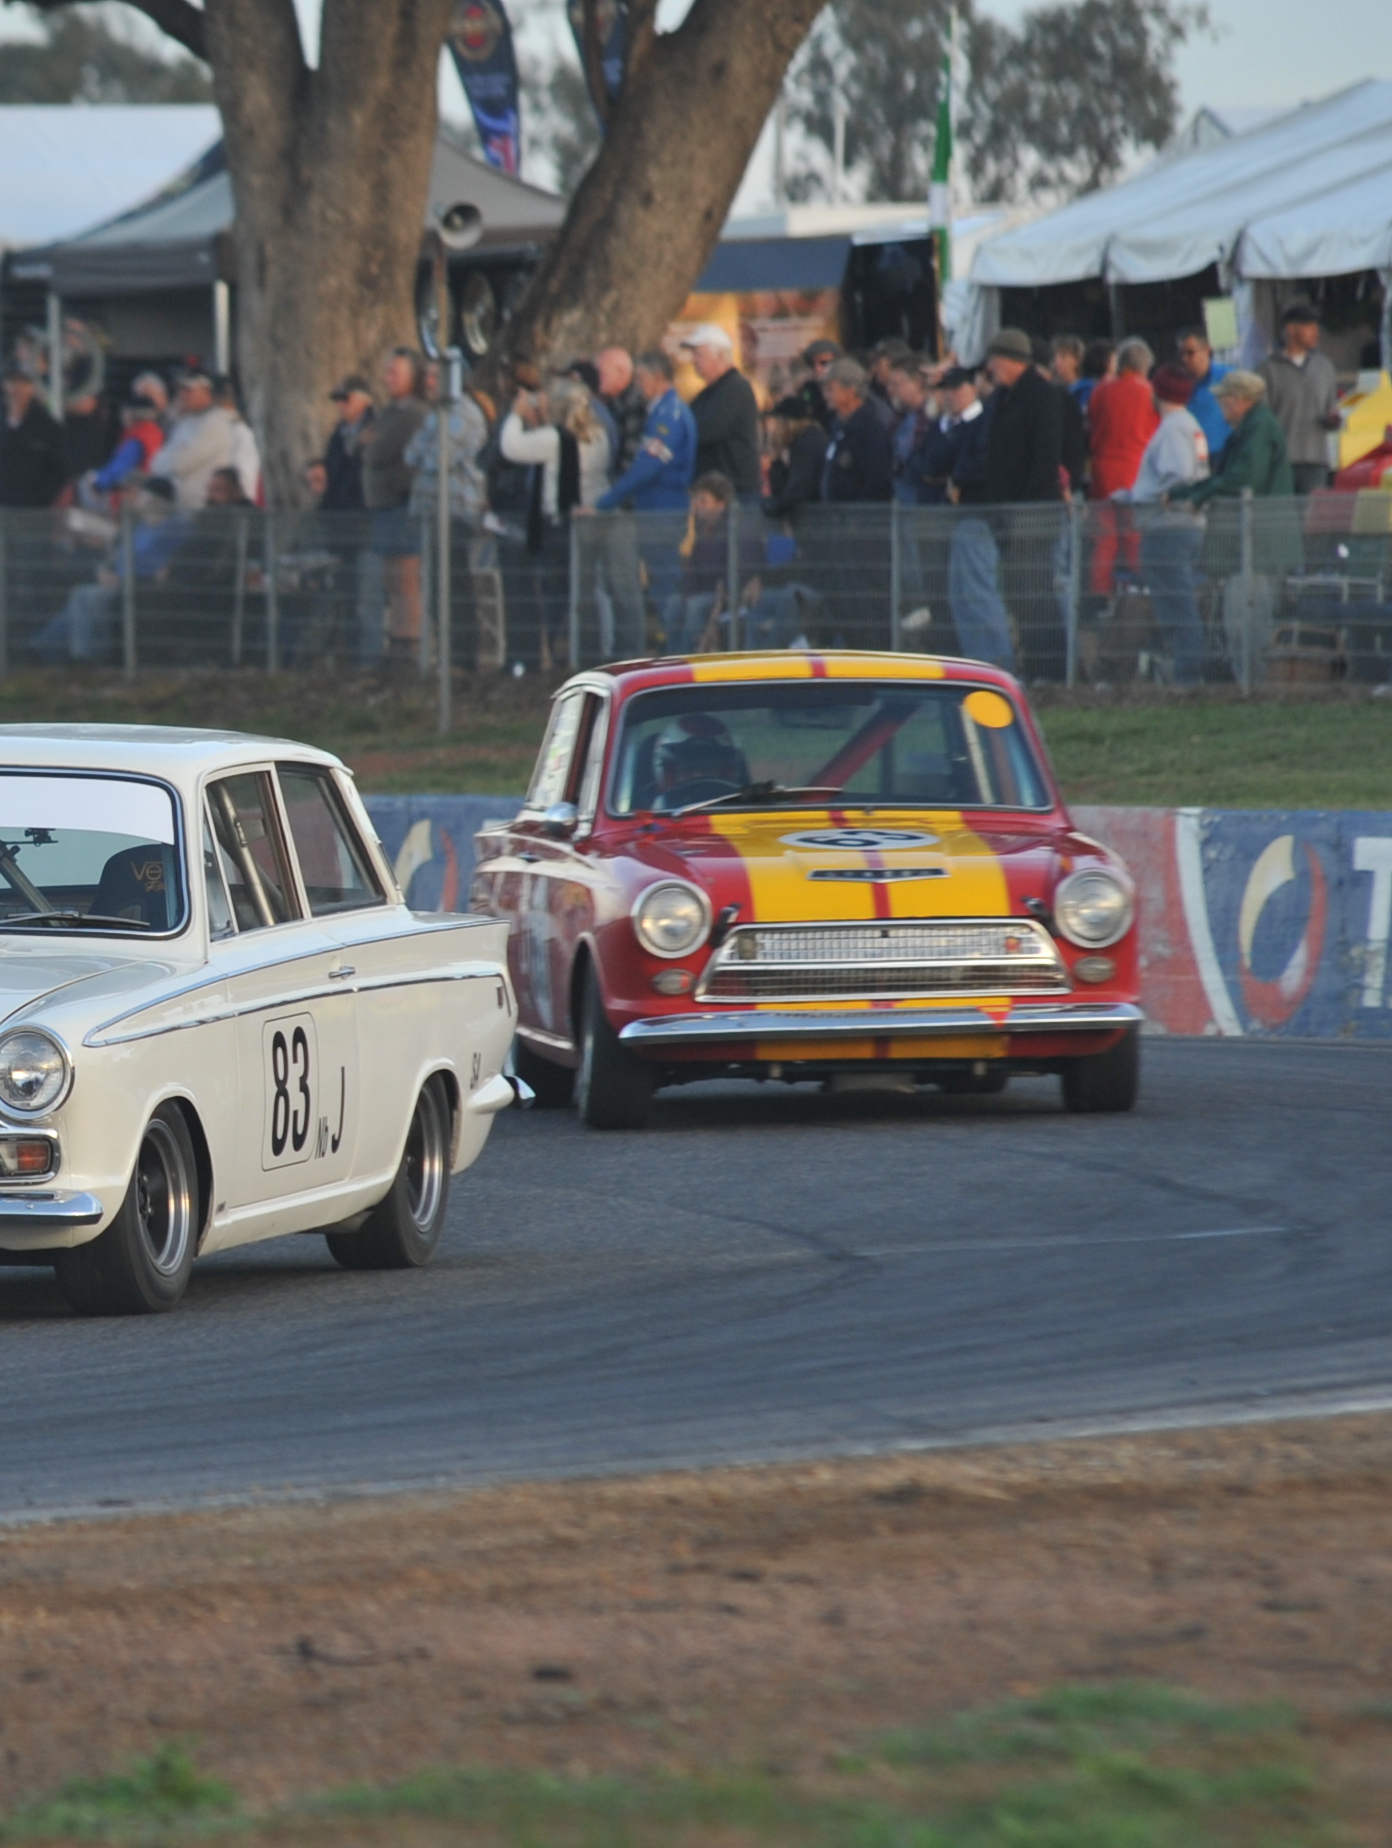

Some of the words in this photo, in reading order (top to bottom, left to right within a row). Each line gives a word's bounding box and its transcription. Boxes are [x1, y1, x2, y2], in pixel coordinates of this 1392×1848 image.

[796, 830, 925, 847] 63
[271, 1025, 311, 1157] 83
[331, 1066, 345, 1154] J
